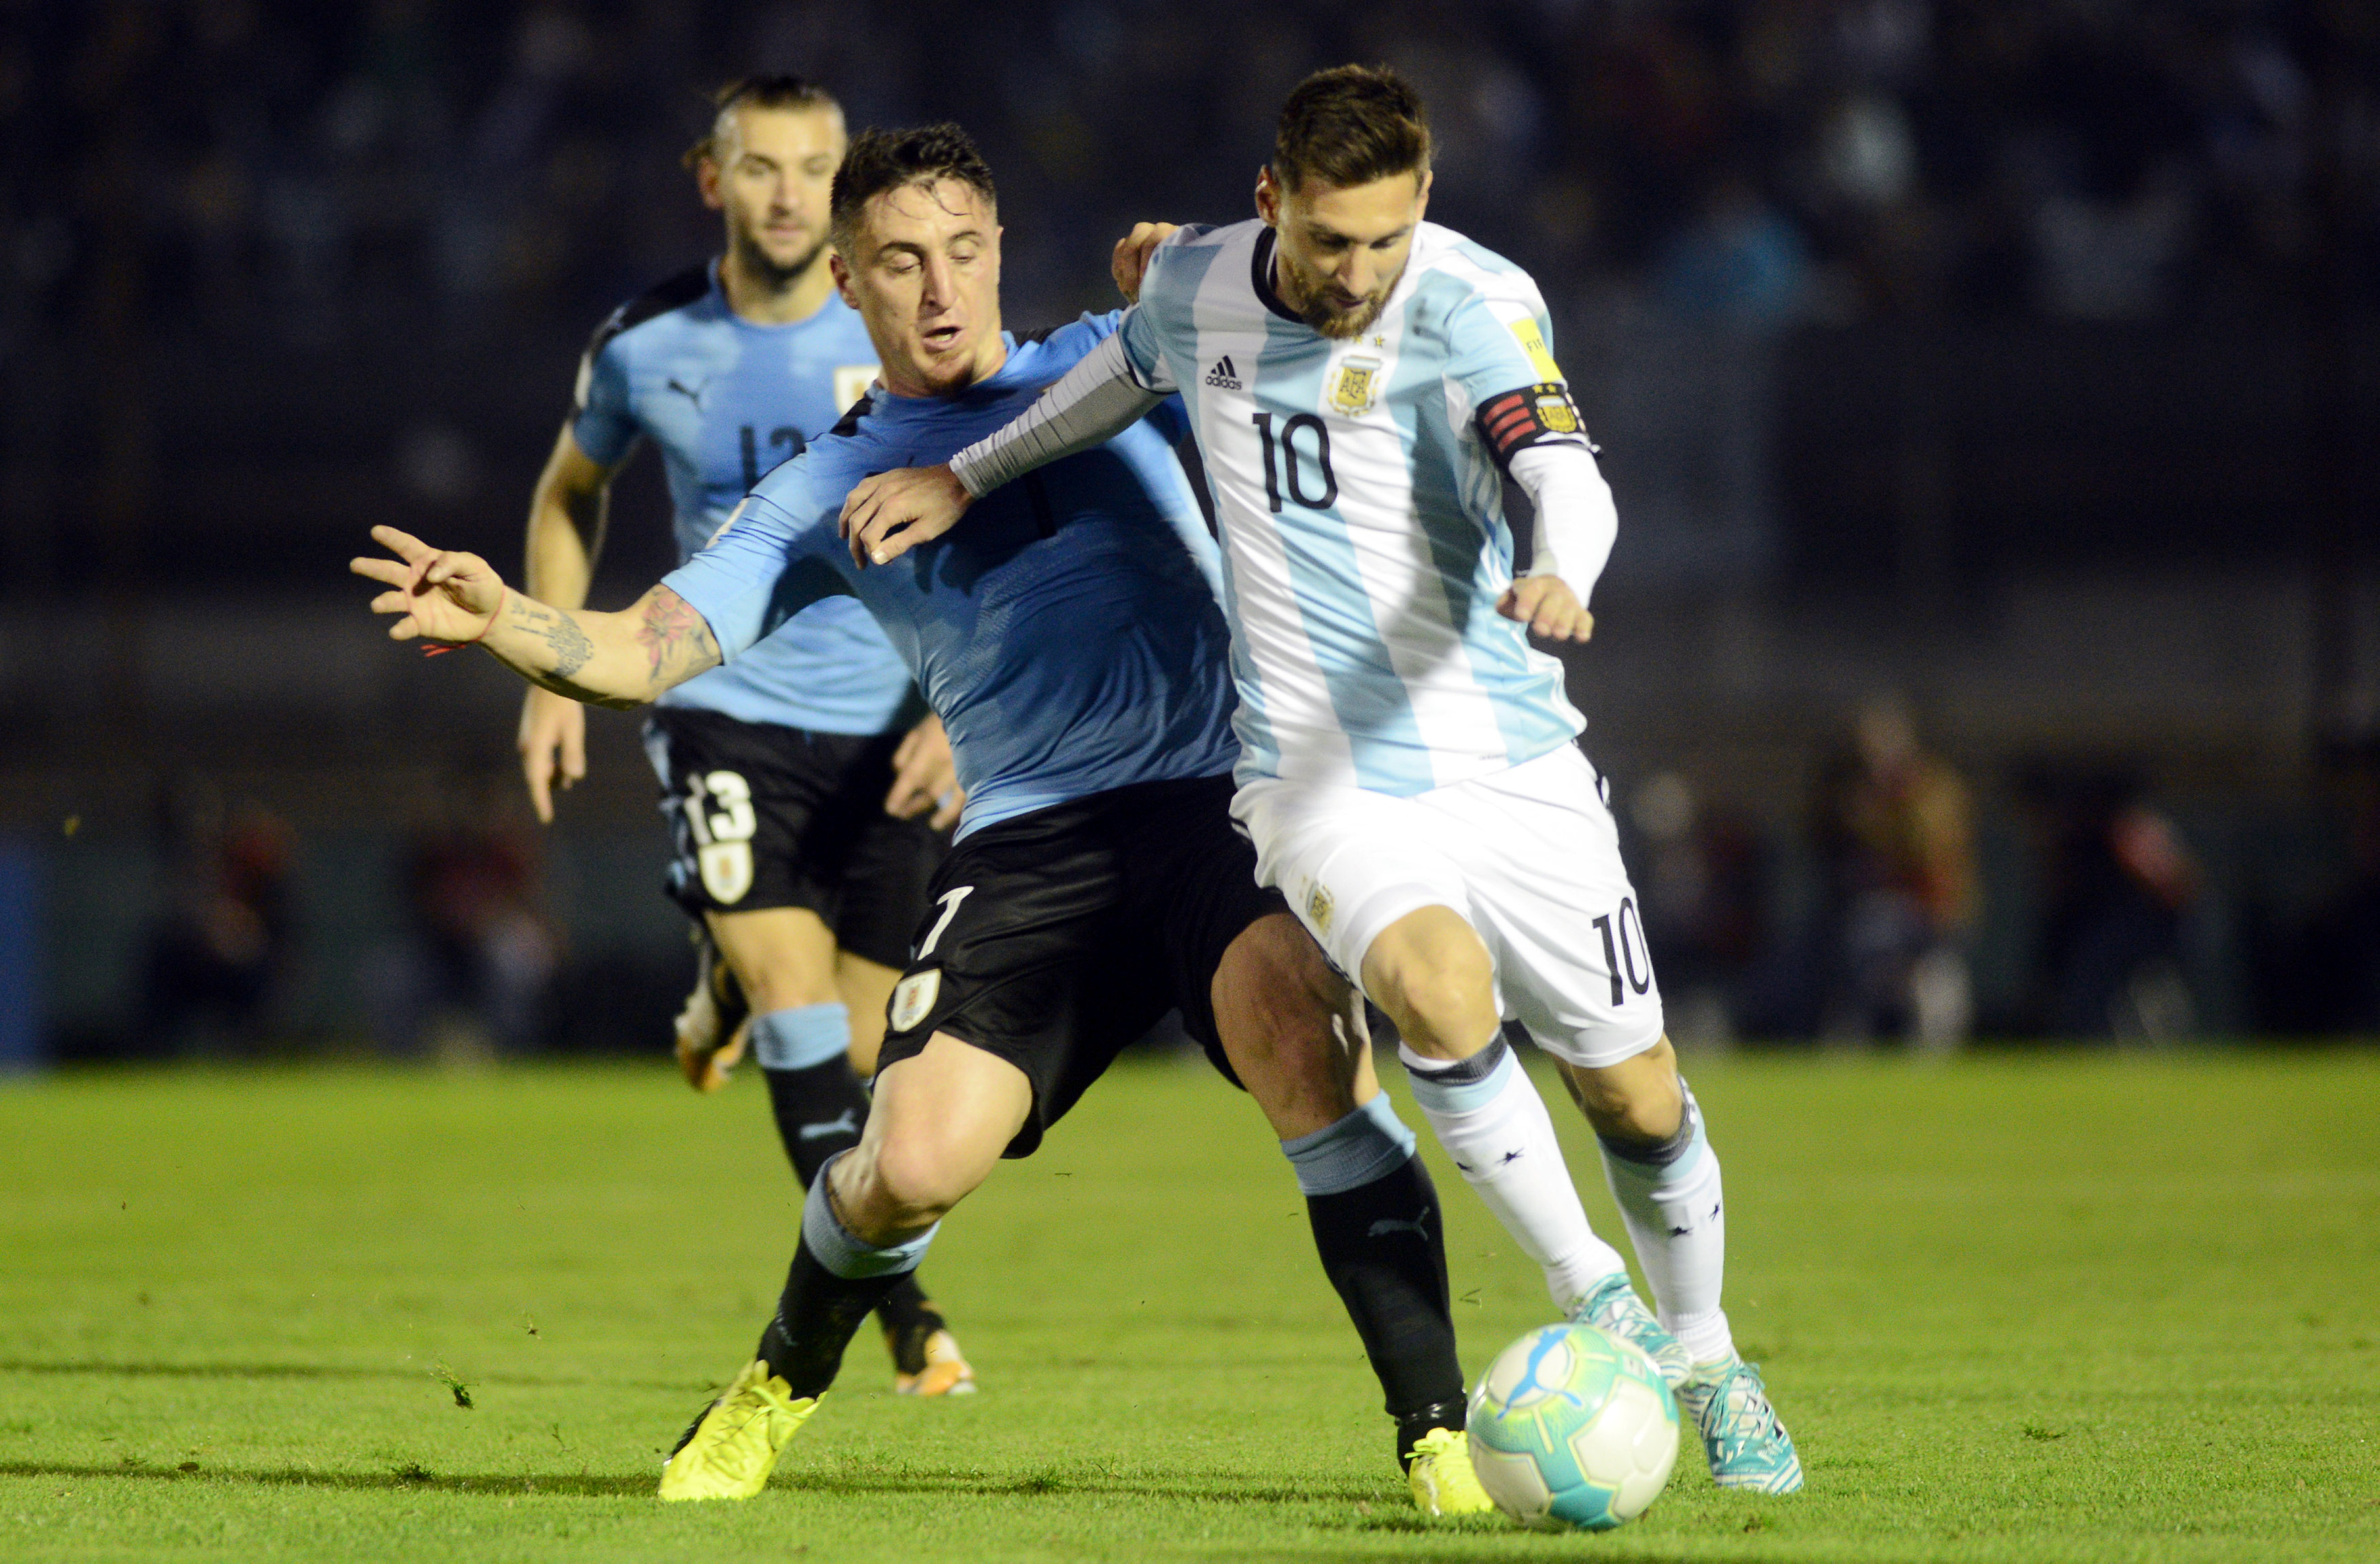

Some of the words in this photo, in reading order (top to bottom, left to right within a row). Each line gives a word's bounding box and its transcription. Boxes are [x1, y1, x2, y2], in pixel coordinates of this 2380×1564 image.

[1205, 375, 1242, 390] adidas
[1253, 413, 1338, 513] 10
[683, 769, 757, 845] 13
[1592, 897, 1649, 1007] 10
